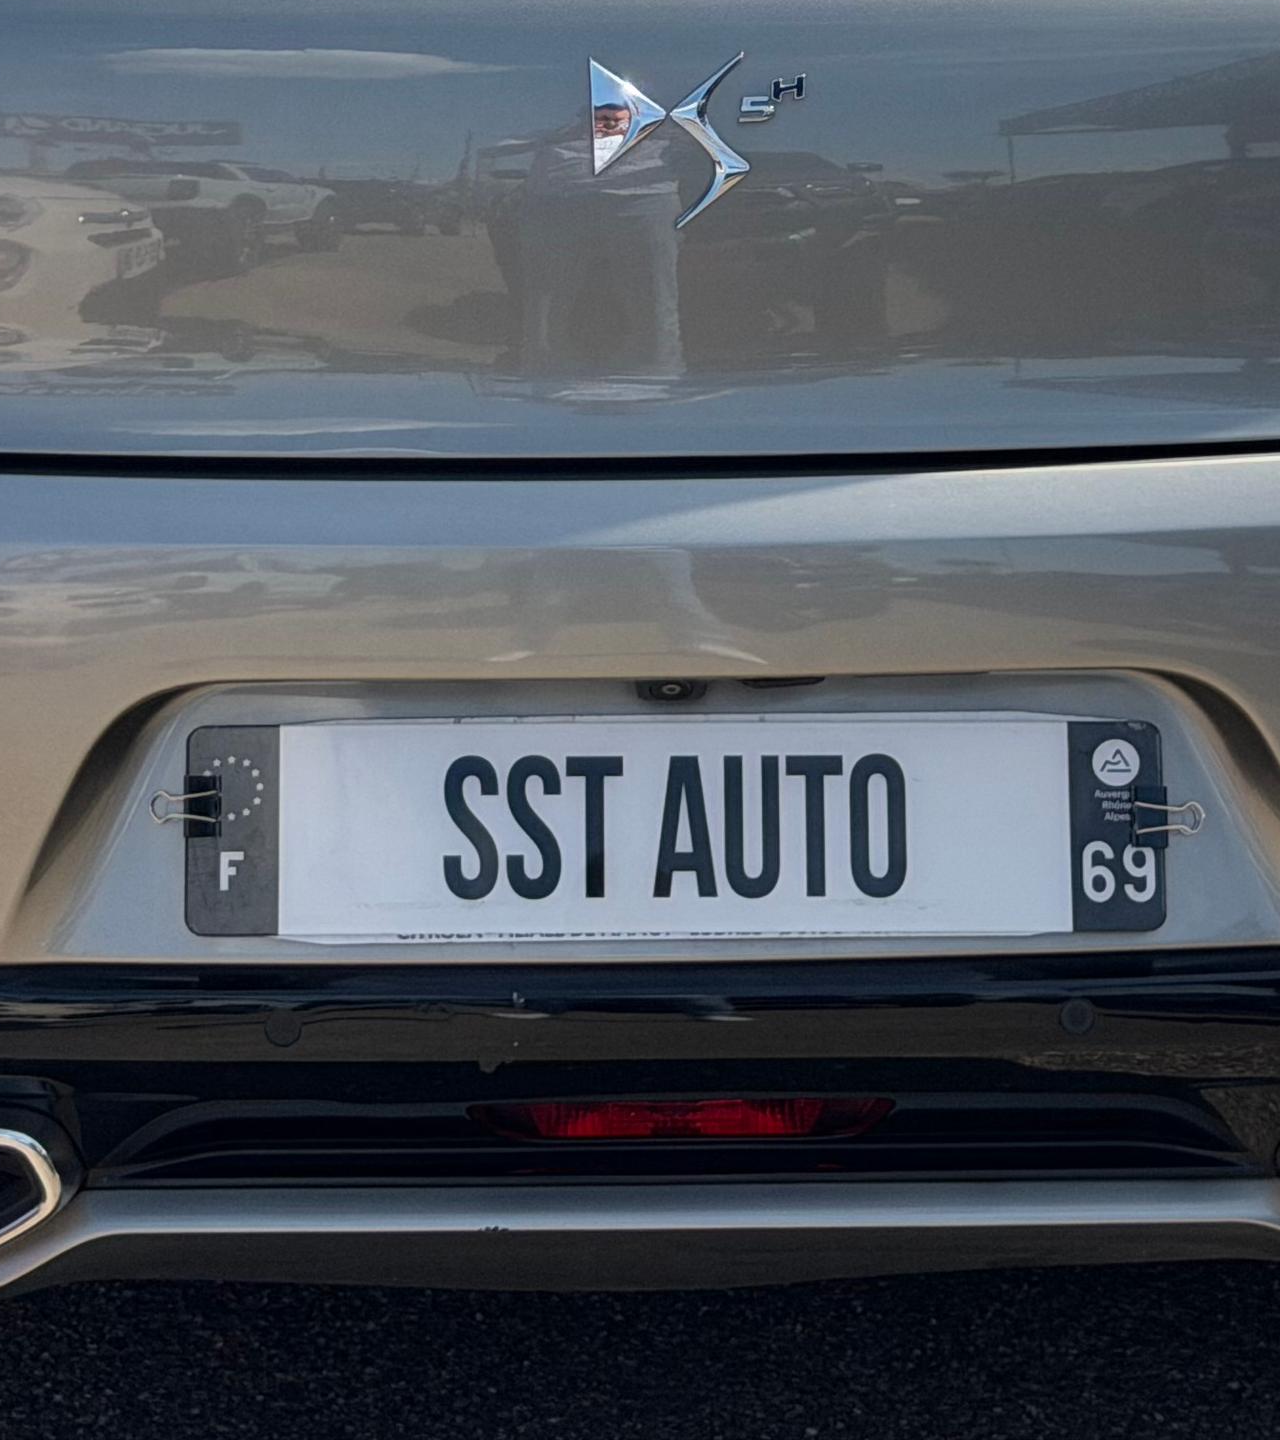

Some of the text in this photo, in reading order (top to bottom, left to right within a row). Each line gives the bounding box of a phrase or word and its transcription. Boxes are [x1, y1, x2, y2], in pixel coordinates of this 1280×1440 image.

[442, 752, 908, 900] SST AUTO
[1103, 811, 1132, 822] Alpes
[219, 850, 245, 891] F
[1082, 840, 1156, 903] 69
